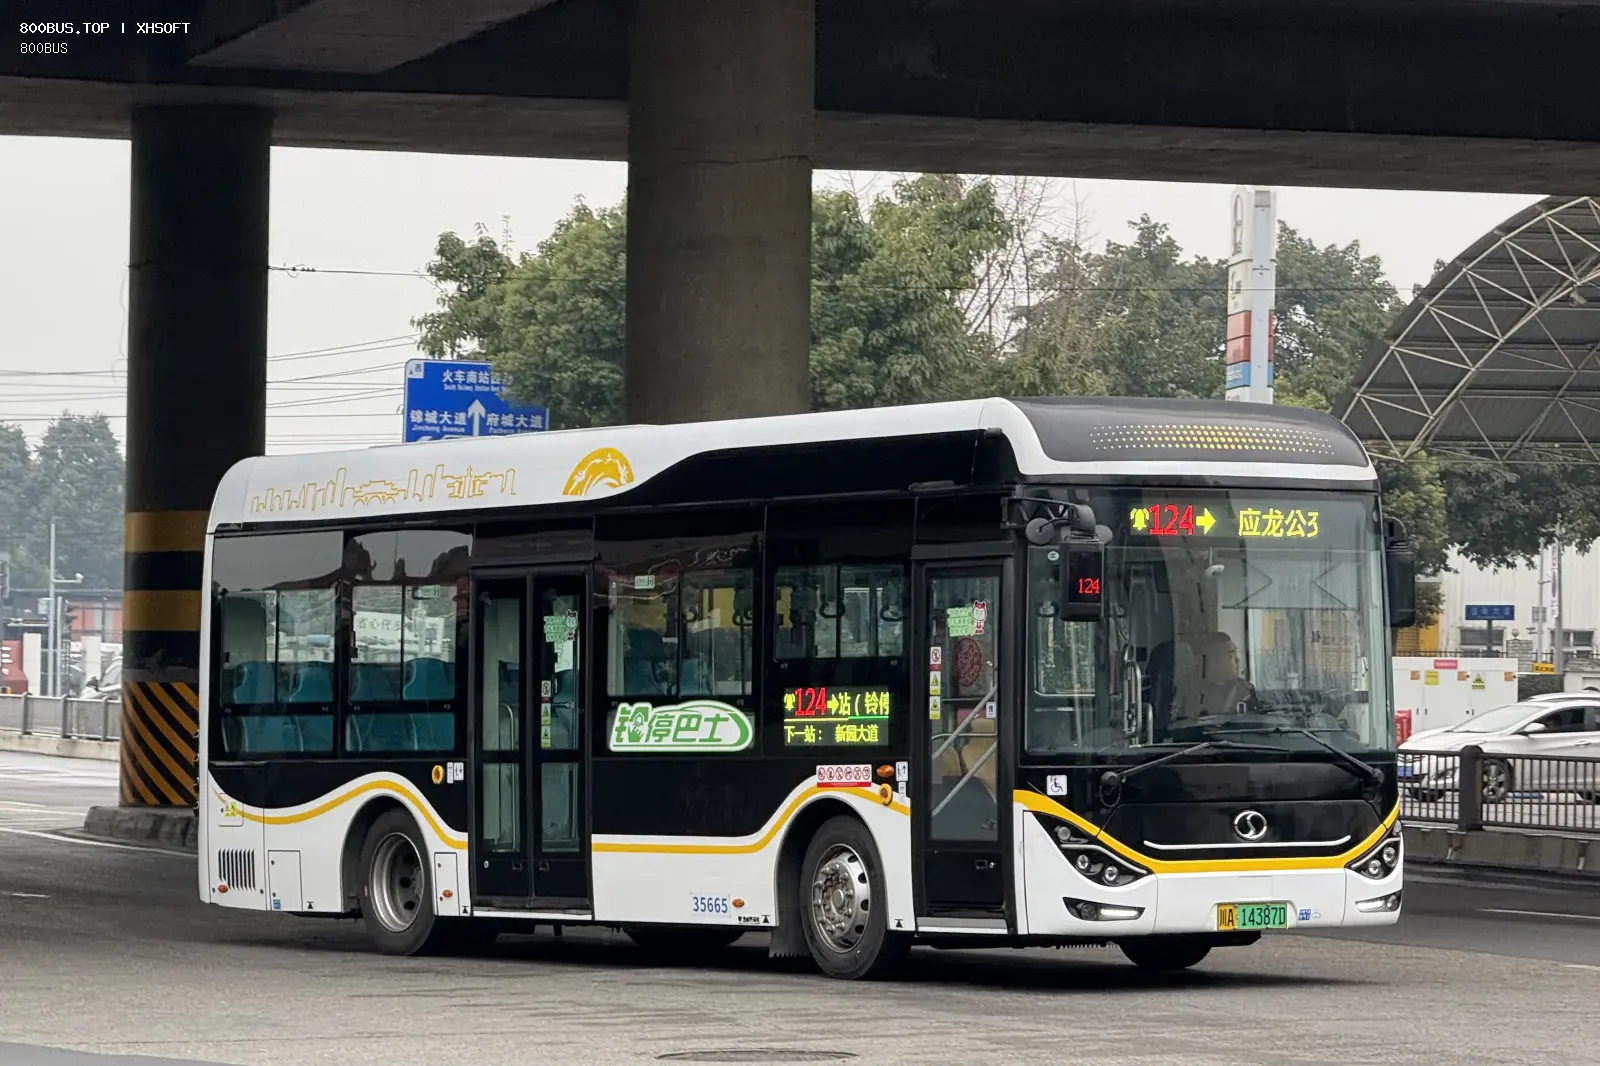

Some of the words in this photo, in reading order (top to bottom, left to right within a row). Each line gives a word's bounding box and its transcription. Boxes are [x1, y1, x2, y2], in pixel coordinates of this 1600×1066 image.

[410, 409, 467, 426] 锦城大道
[486, 412, 544, 429] 府城大道
[1148, 503, 1195, 536] 124
[1078, 578, 1101, 594] 124
[794, 687, 828, 716] 124
[835, 723, 879, 742] 新园大道
[692, 896, 729, 914] 35665
